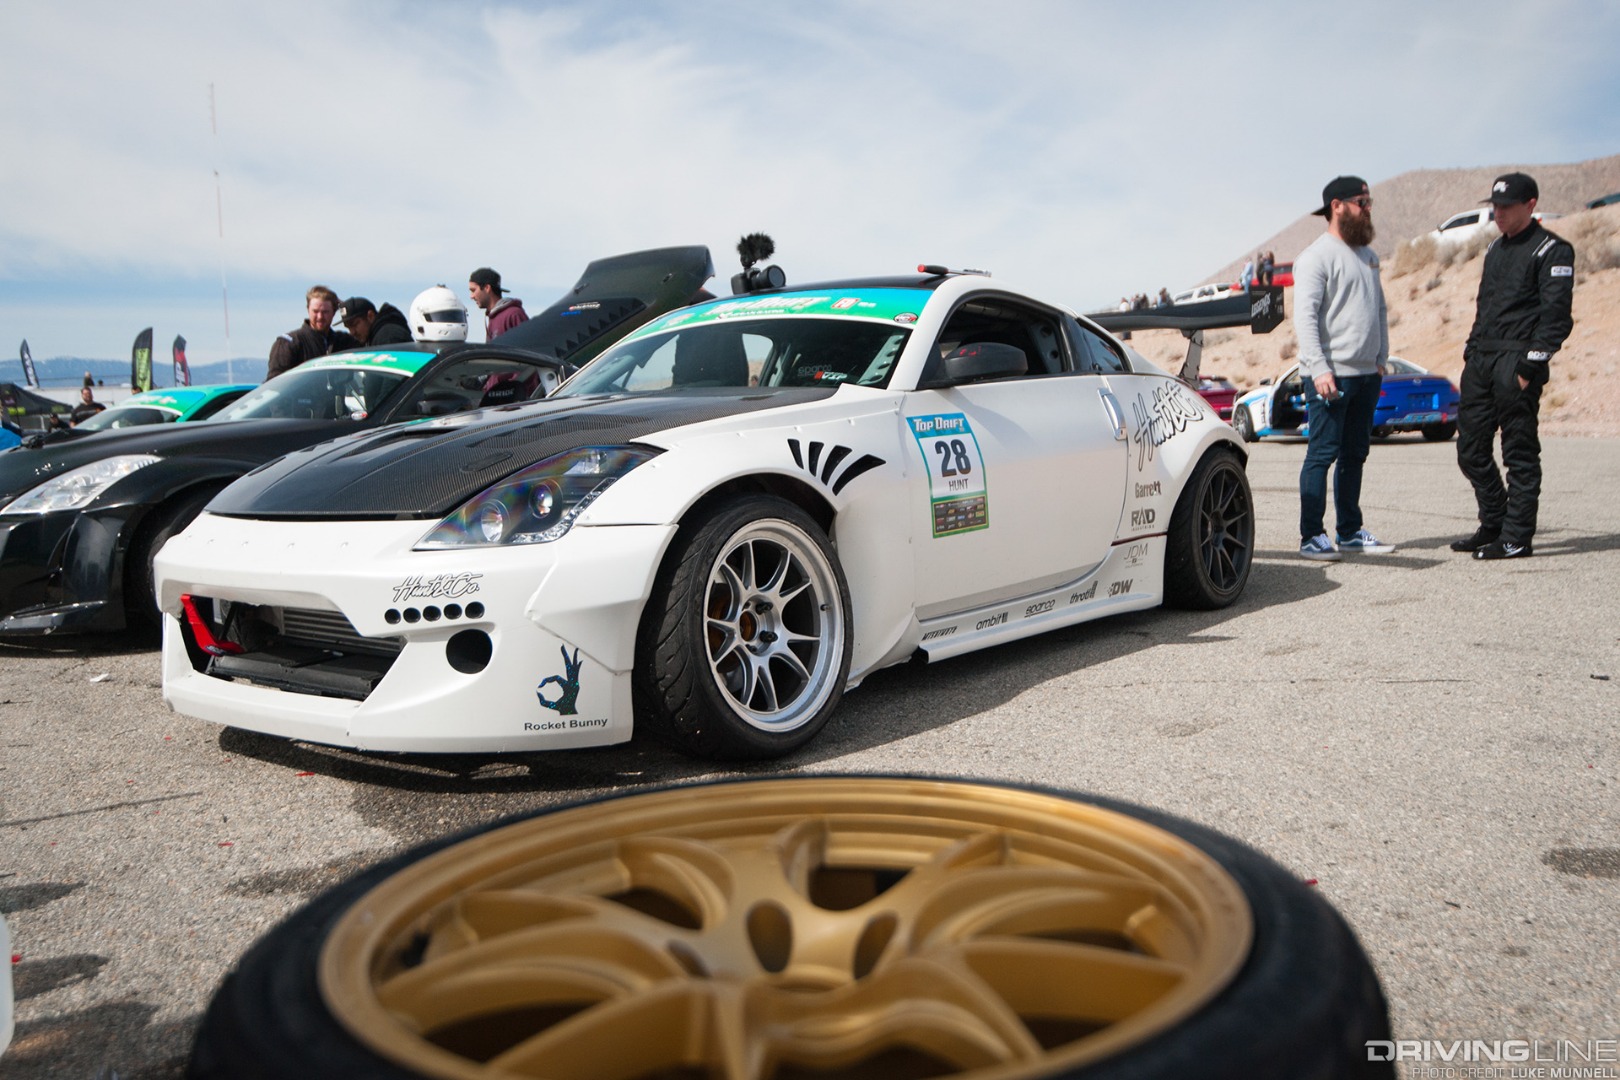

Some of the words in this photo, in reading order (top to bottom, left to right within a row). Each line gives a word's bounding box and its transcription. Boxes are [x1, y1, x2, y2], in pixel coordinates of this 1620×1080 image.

[935, 439, 972, 478] 28
[948, 478, 969, 492] HUNT
[1131, 507, 1156, 527] RAD
[1123, 543, 1149, 560] JDM
[524, 720, 567, 732] Rocket
[569, 717, 609, 730] Bunny
